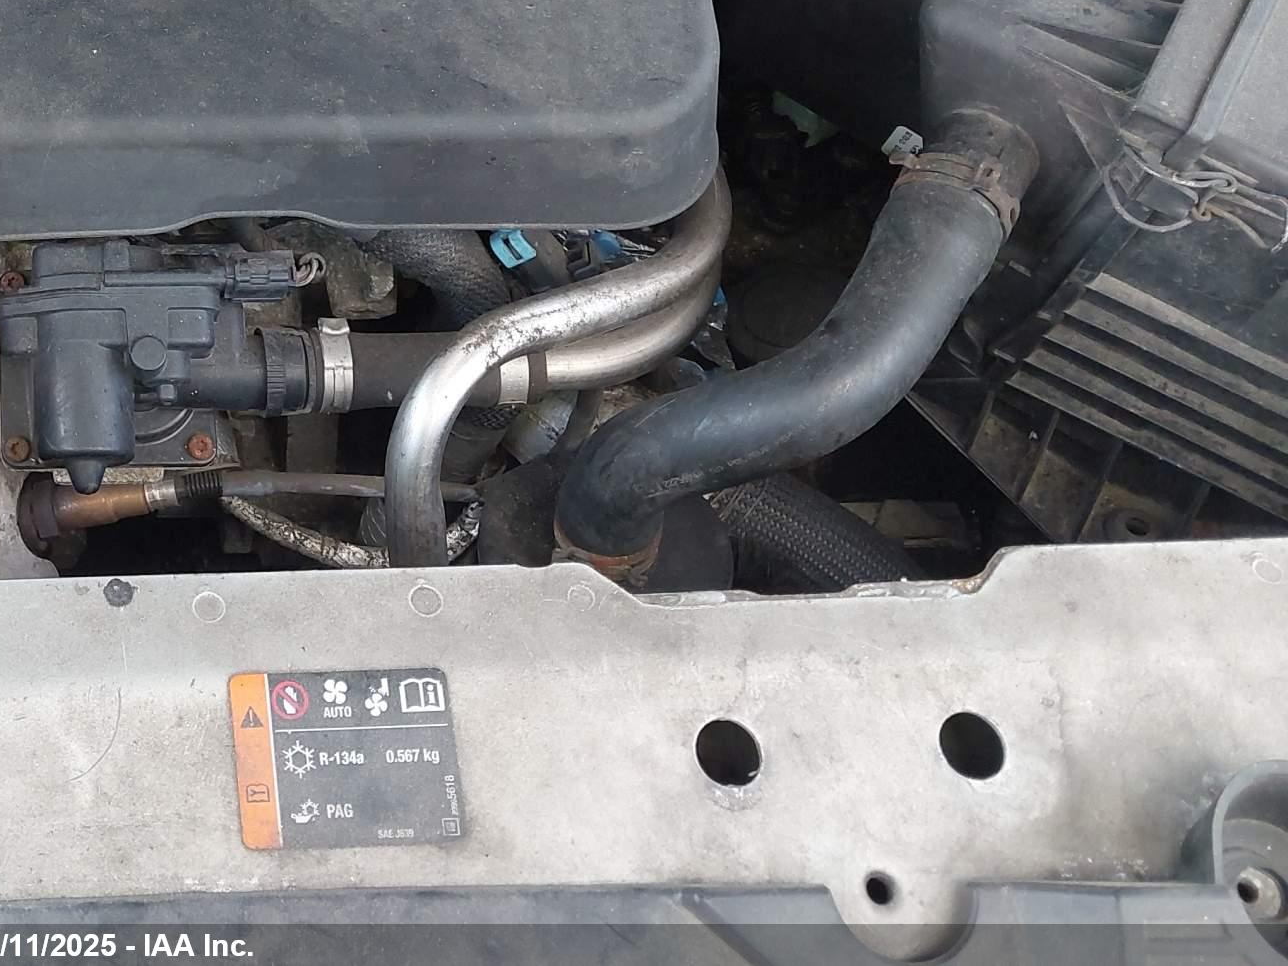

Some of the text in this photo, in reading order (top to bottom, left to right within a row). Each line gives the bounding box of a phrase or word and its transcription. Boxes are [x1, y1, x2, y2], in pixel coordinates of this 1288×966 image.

[323, 705, 352, 718] AUTO
[319, 749, 440, 765] R-134a 0.567 kg
[326, 804, 354, 818] PAG
